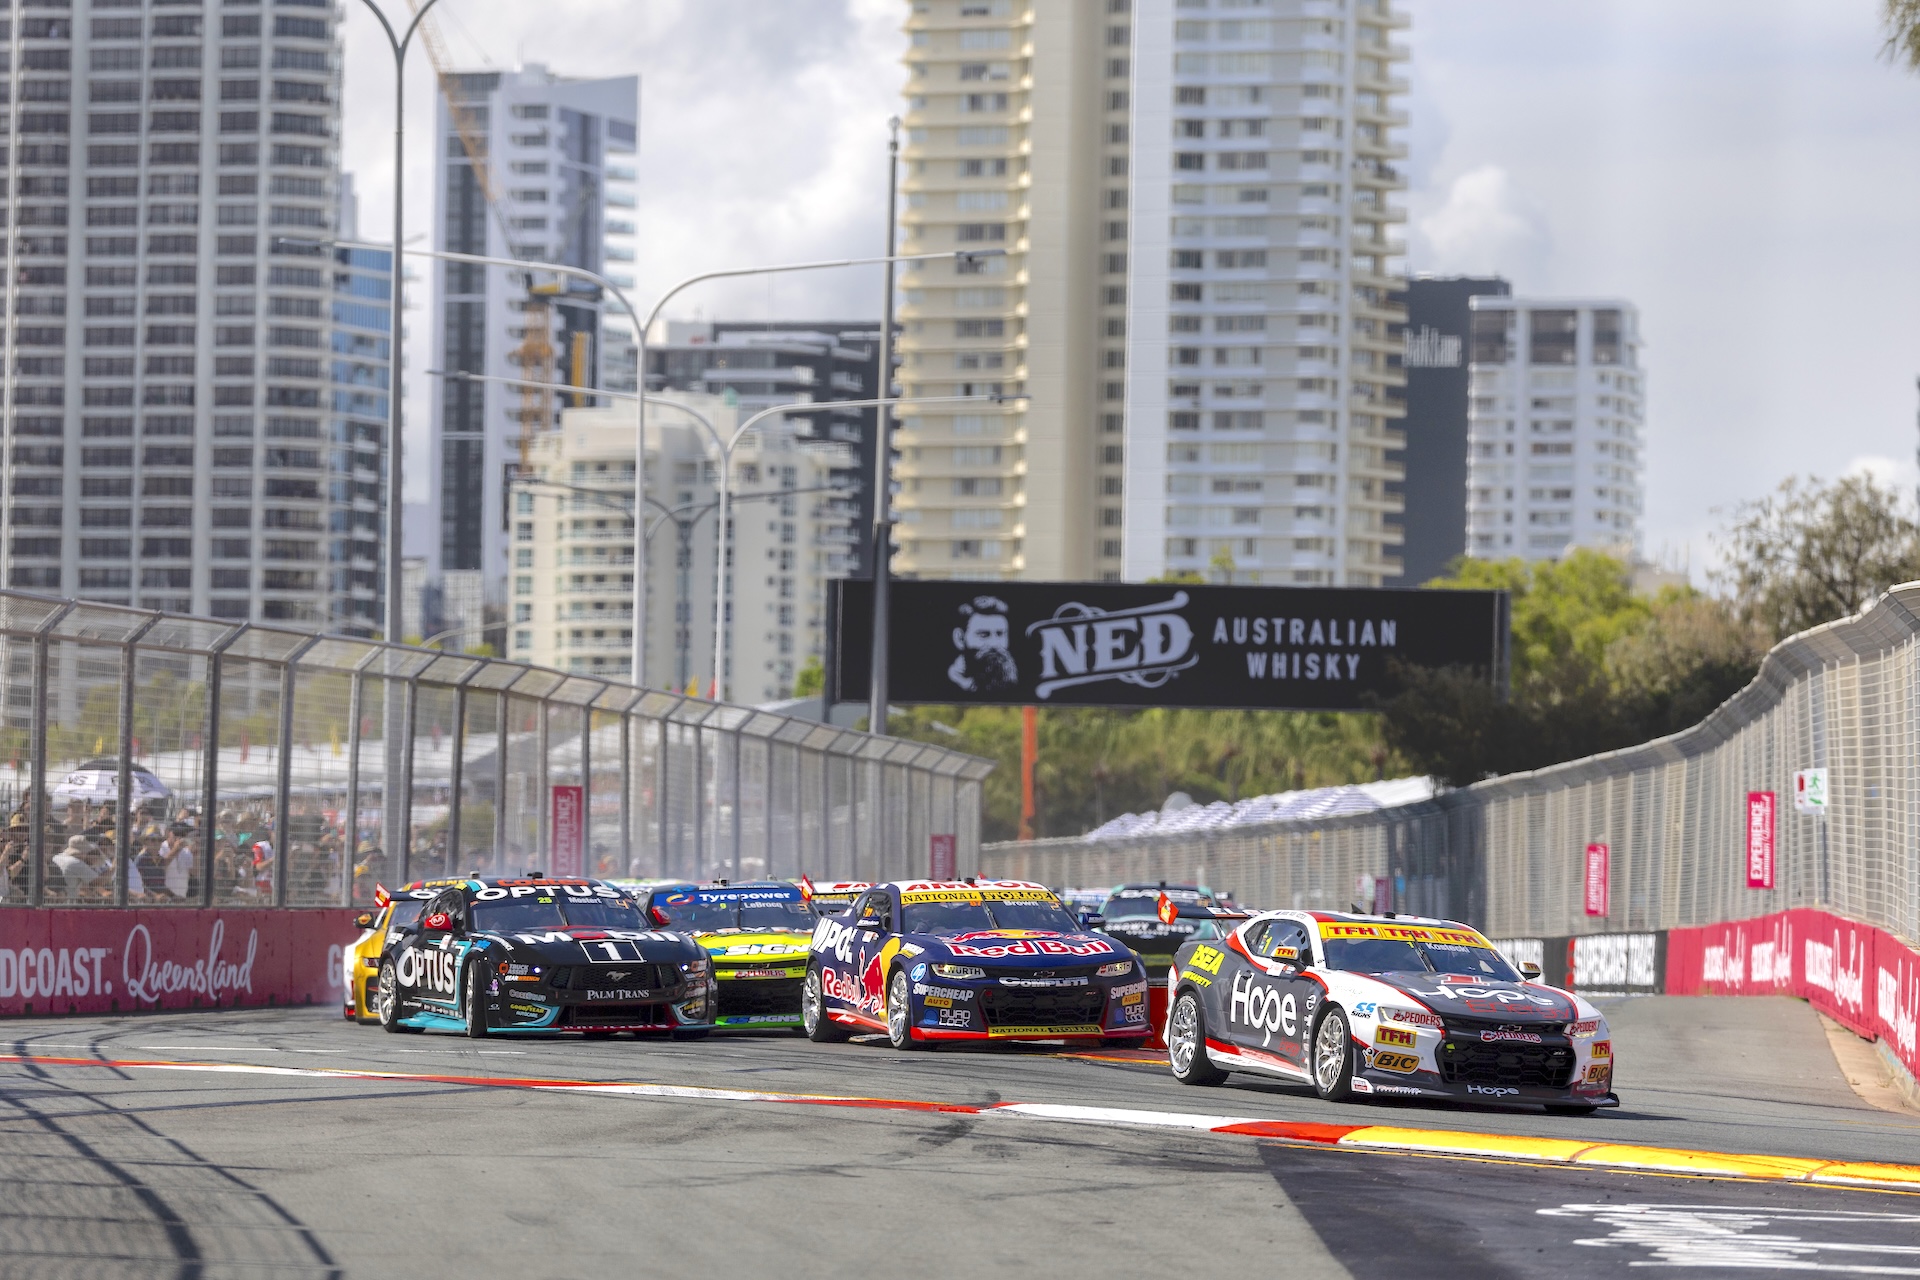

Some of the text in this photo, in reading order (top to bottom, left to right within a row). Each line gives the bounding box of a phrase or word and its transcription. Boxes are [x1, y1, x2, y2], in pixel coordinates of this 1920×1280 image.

[1212, 617, 1398, 646] AUSTRALIAN
[1039, 612, 1193, 678] NED
[1246, 652, 1361, 680] WHISKY
[1750, 800, 1764, 880] EXPERIENCE
[475, 885, 621, 900] OPTUS
[699, 891, 791, 903] Tyrepower
[903, 891, 1051, 902] NATIONAL STORAGE
[744, 901, 783, 909] LeBrocq
[514, 930, 681, 945] Mobil
[1329, 926, 1480, 944] TFH TFH TFH
[598, 942, 622, 961] 1
[945, 940, 1040, 958] Red
[1035, 940, 1115, 958] Bull
[1278, 948, 1294, 956] TFH
[1426, 942, 1470, 953] Kostecki
[123, 918, 258, 1003] Queensland
[397, 946, 455, 994] OPTUS
[823, 966, 846, 1000] Red
[587, 989, 650, 1000] PALM TRANS
[913, 983, 974, 1001] SUPERCHEAP
[1407, 985, 1554, 1006] Hope
[927, 998, 950, 1006] AUTO
[1124, 995, 1139, 1003] AUTO
[510, 1003, 545, 1013] GOODYEAR
[1125, 1004, 1146, 1015] QUAD
[1230, 970, 1297, 1047] Hope
[1356, 1002, 1377, 1013] SS
[1465, 1000, 1570, 1019] Energy
[748, 1015, 800, 1023] SIGNS
[939, 1009, 971, 1020] QUAD
[1125, 1013, 1147, 1023] LOCK
[1351, 1010, 1372, 1019] SIGNS
[1404, 1011, 1441, 1026] PEDDERS
[939, 1018, 970, 1027] LOCK
[1577, 1021, 1597, 1032] PEDDERS
[1379, 1028, 1412, 1044] TFH
[1496, 1031, 1541, 1043] PEDDERS
[1594, 1042, 1610, 1055] TFH
[1467, 1085, 1520, 1097] Hope
